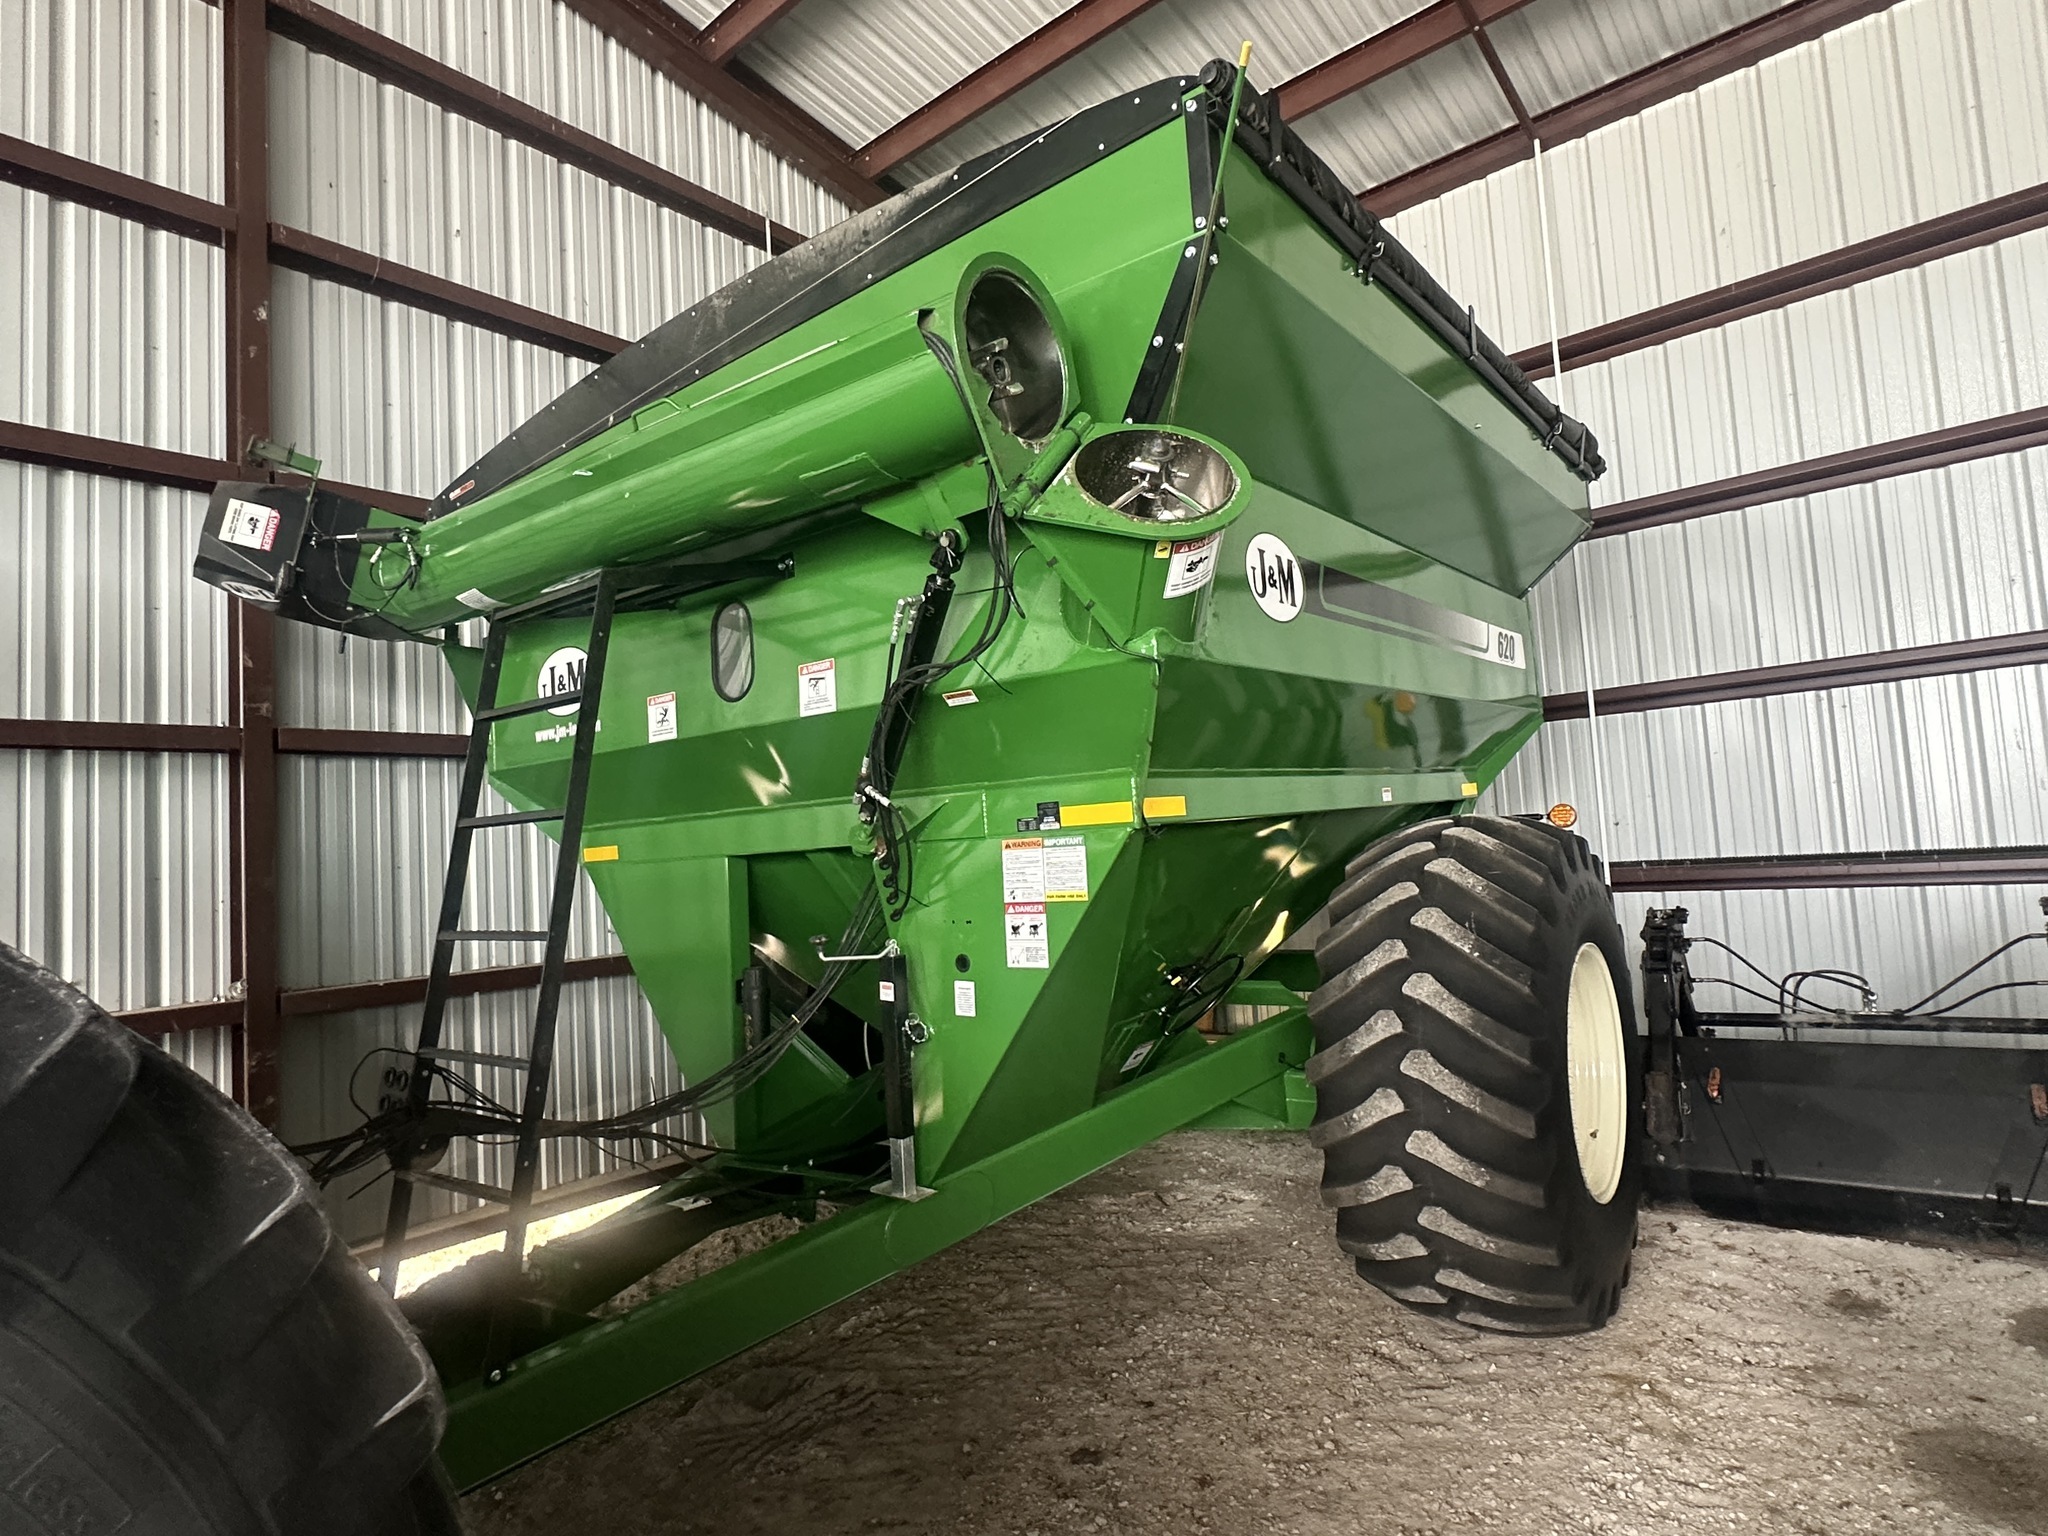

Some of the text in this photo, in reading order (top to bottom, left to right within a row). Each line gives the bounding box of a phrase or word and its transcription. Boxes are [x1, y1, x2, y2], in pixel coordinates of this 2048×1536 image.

[1250, 547, 1297, 608] J&M
[1497, 631, 1515, 661] 620
[1009, 840, 1040, 849] WARNING
[1042, 836, 1084, 847] IMPORTANT
[1015, 904, 1044, 914] DANGER
